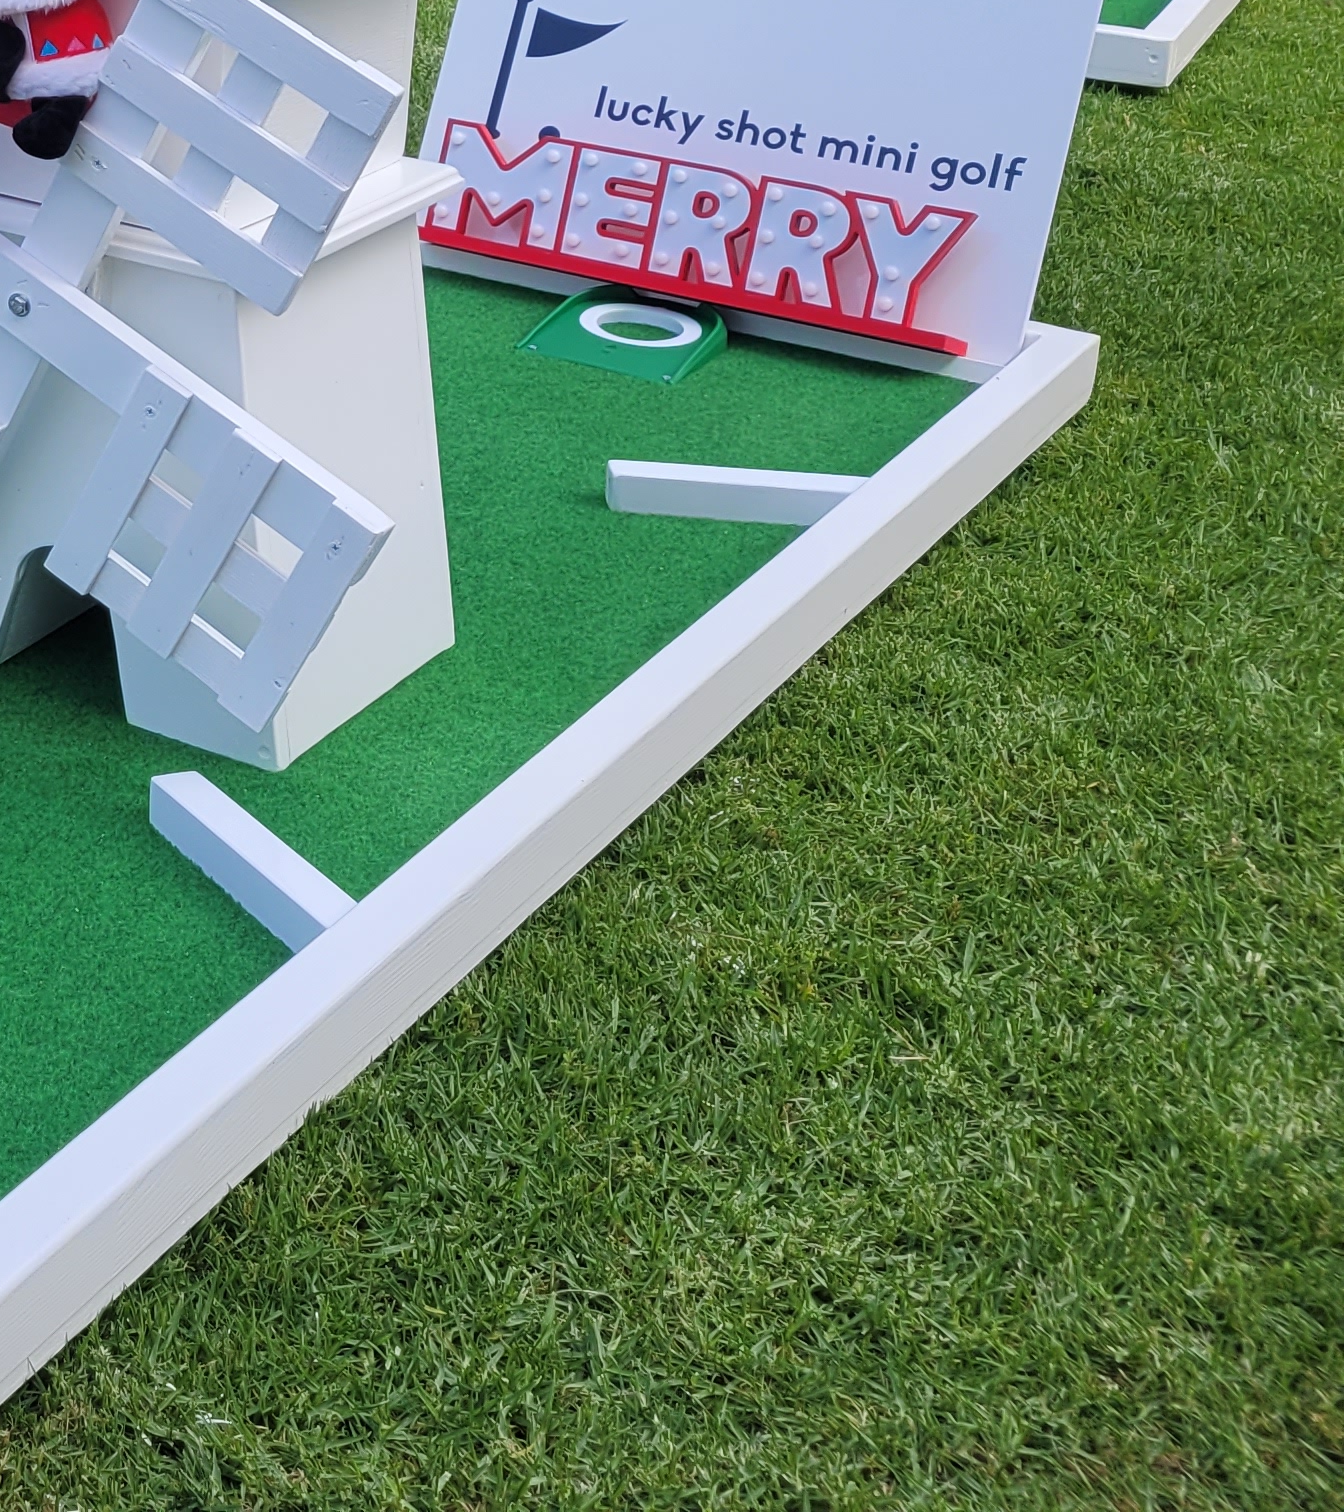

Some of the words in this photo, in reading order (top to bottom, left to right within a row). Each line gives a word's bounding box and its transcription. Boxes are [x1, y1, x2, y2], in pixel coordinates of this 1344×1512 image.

[593, 85, 705, 146] lucky
[715, 110, 806, 154] shot
[818, 135, 918, 173] mini
[929, 153, 1027, 191] golf
[424, 118, 978, 328] MERRY
